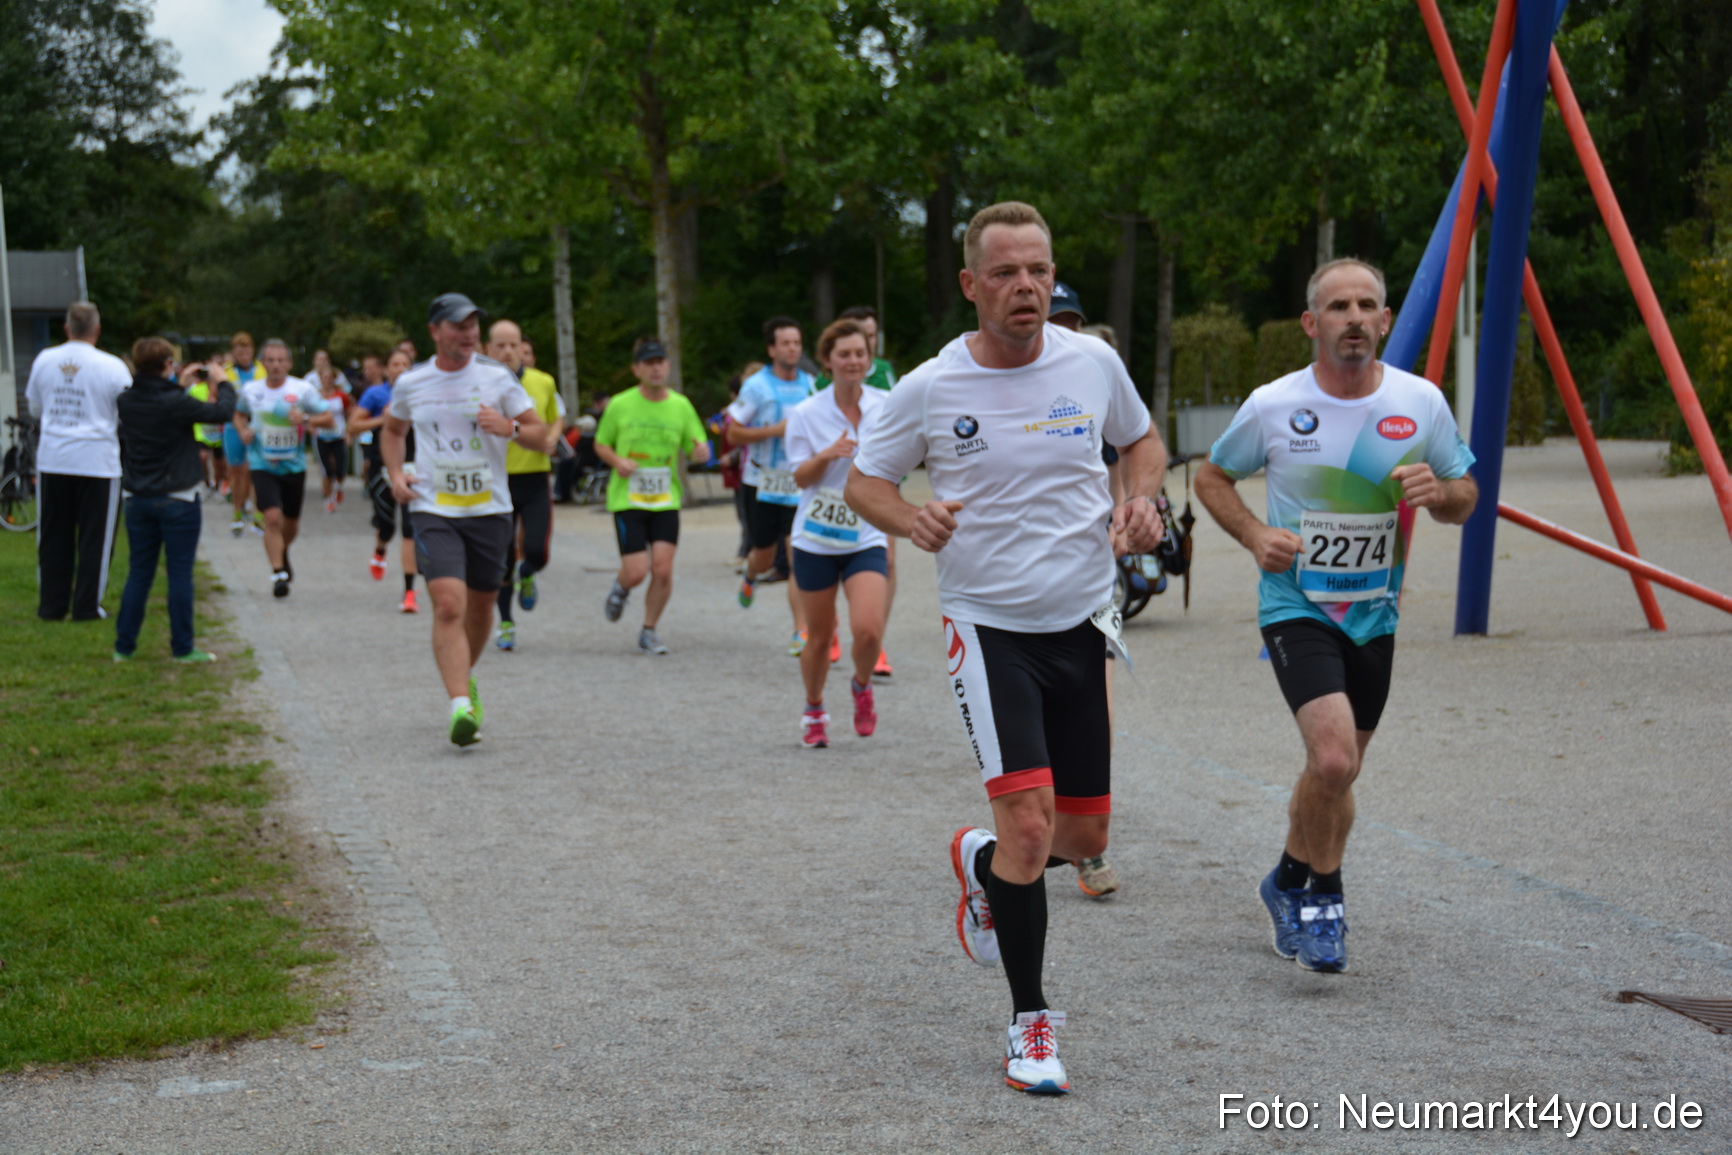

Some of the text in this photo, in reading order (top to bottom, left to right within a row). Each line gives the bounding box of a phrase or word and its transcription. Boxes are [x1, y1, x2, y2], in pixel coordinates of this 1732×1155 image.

[955, 438, 988, 452] PARTL
[1289, 439, 1320, 448] PARTL
[957, 445, 989, 458] Neumarkt
[446, 472, 483, 493] 516
[811, 499, 858, 527] 2483
[1303, 519, 1383, 533] PARTL Neumarkt
[1309, 534, 1387, 568] 2274
[1326, 576, 1368, 590] Hubert
